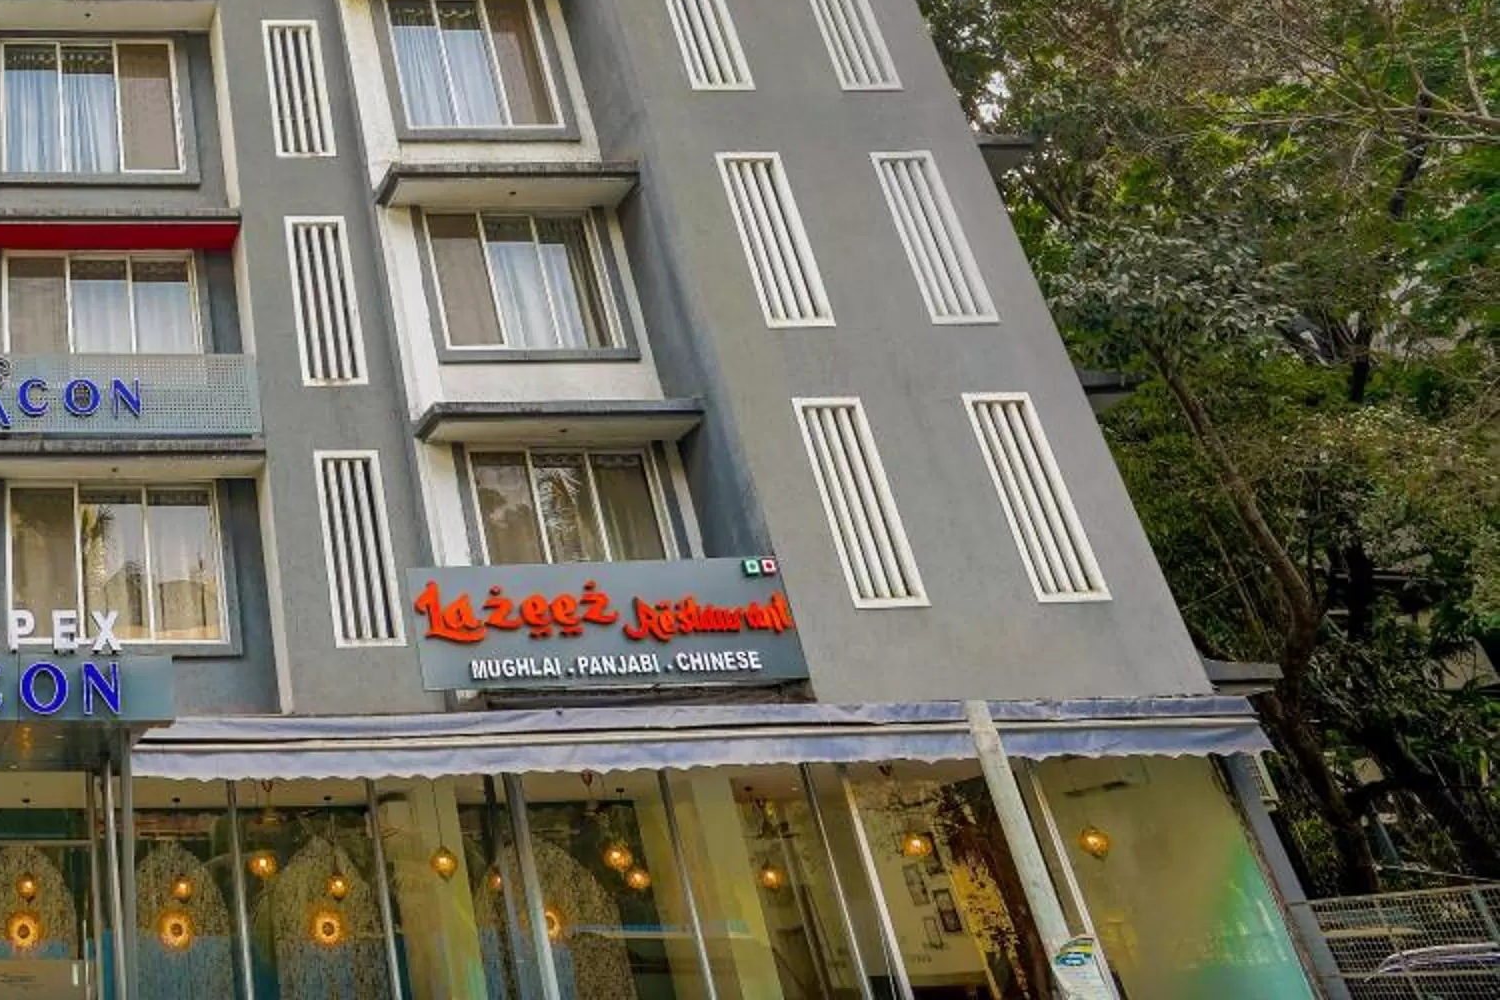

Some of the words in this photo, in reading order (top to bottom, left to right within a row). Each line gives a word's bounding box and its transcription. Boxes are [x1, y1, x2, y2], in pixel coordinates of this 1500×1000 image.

[471, 654, 562, 681] MUGHLAI
[577, 652, 661, 677] PANJABI
[675, 650, 763, 672] CHINESE
